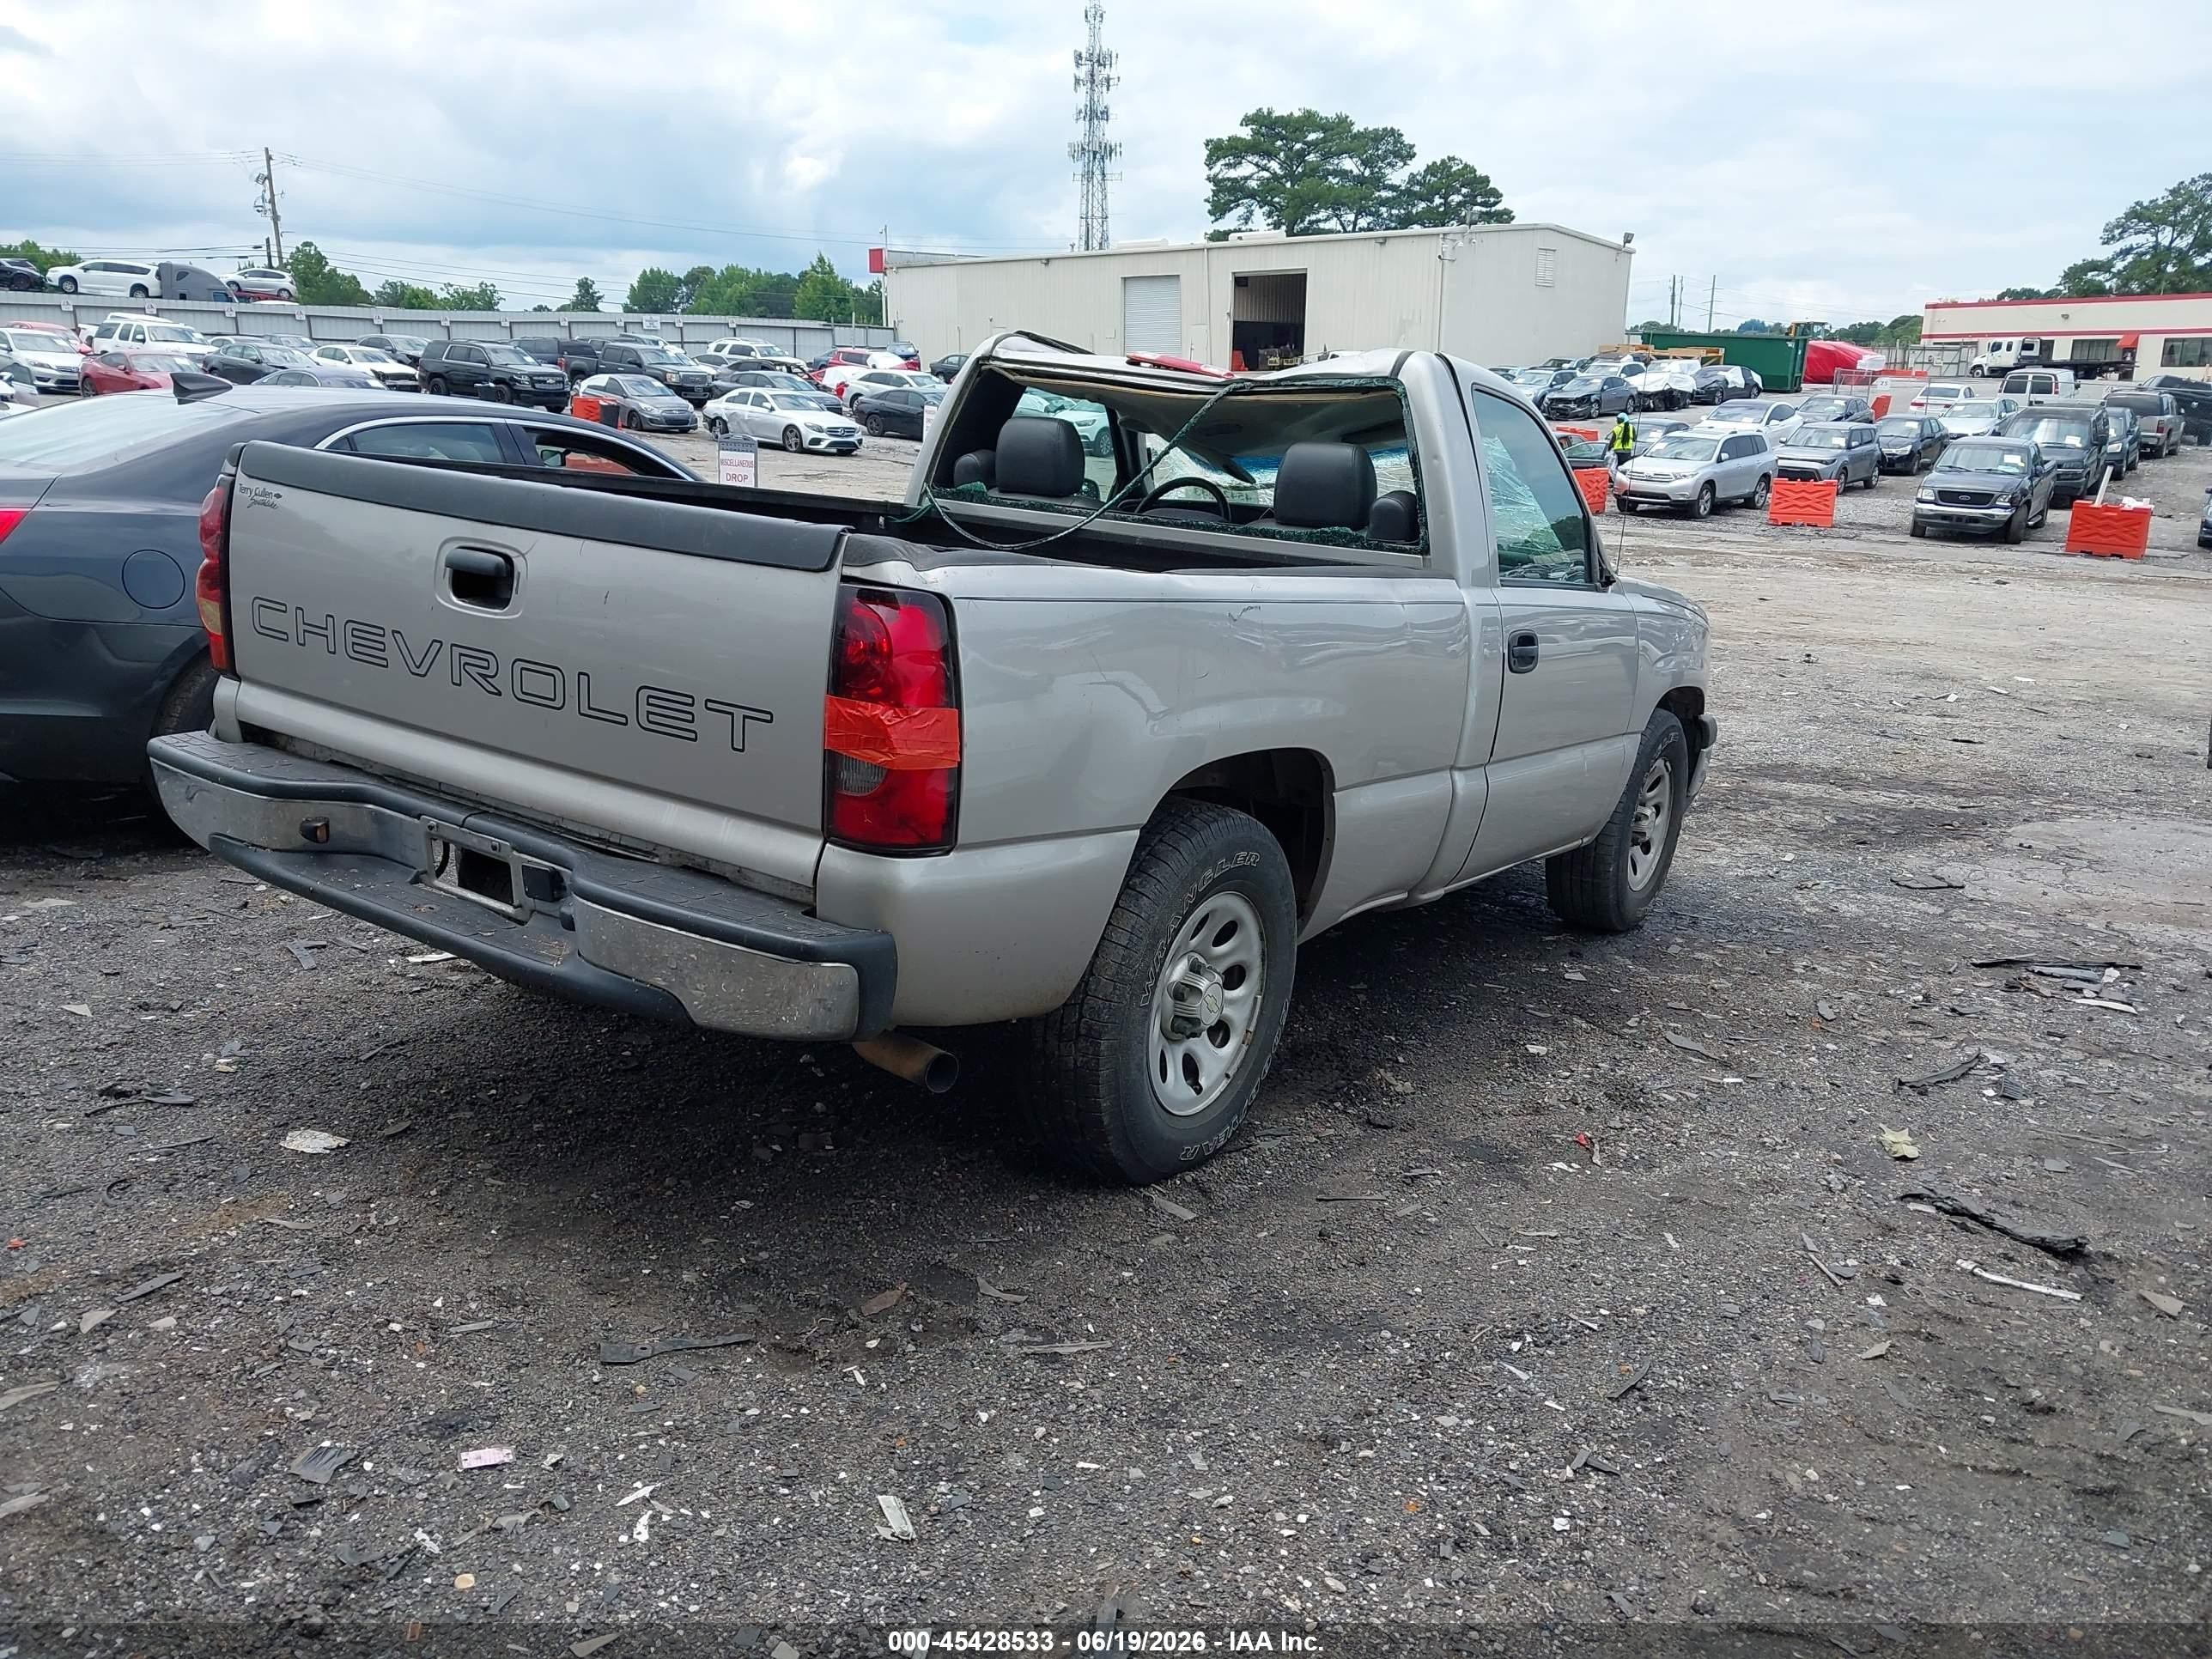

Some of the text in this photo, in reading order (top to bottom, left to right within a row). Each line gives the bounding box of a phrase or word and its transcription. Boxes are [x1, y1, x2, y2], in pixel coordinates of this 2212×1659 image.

[239, 483, 273, 500] Terry Cullen
[726, 472, 749, 483] DROP
[251, 595, 774, 752] CHEVROLET
[1139, 852, 1261, 1006] WRANGLER
[1180, 999, 1289, 1160] GOODYEAR
